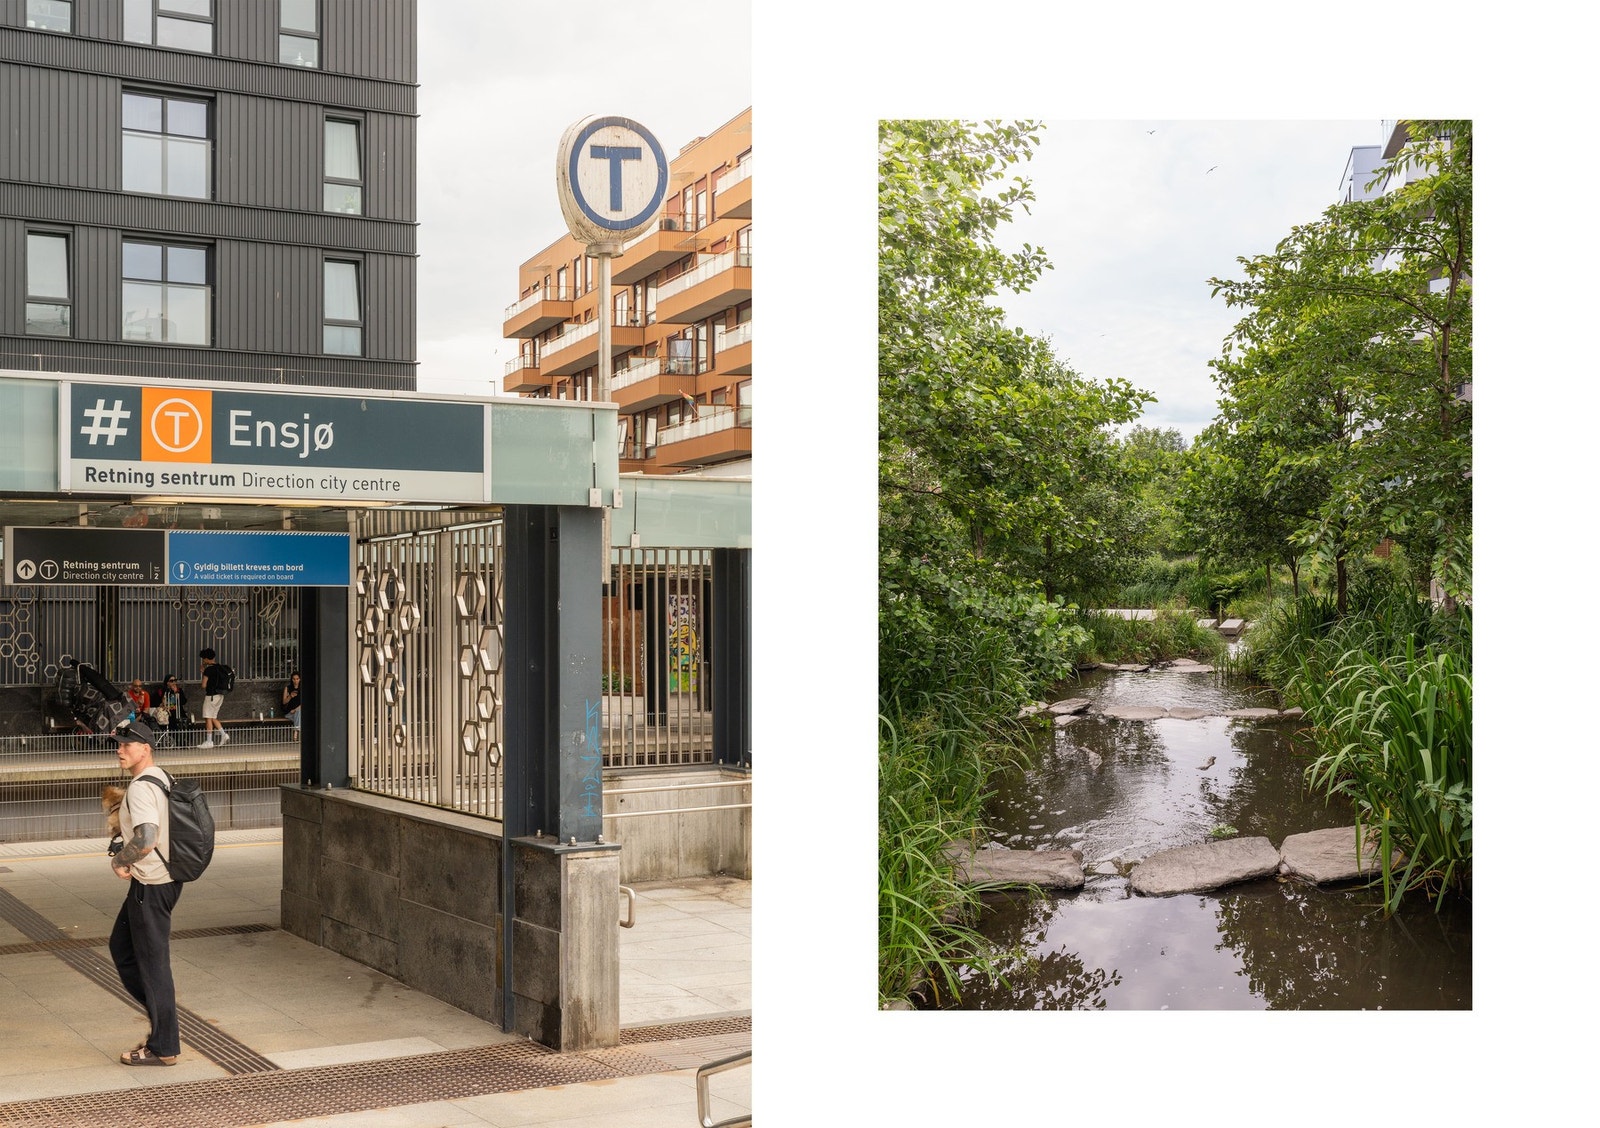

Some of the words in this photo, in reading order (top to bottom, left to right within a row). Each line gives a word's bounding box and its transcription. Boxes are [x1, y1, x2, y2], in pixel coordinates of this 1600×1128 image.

[590, 145, 642, 211] T
[229, 409, 334, 459] Ensjø
[85, 466, 155, 488] Retning
[160, 471, 235, 487] sentrum
[242, 472, 315, 489] Direction
[320, 475, 348, 494] city
[352, 477, 401, 492] centre
[63, 560, 99, 571] Retning
[101, 561, 140, 570] sentrum
[193, 562, 219, 572] Gyldig
[221, 563, 244, 571] billett
[245, 563, 271, 571] kreves
[285, 563, 304, 571] bord
[63, 570, 101, 580] Direction
[101, 572, 117, 582] city
[118, 572, 144, 580] centre
[154, 572, 159, 580] 2
[240, 573, 266, 581] required
